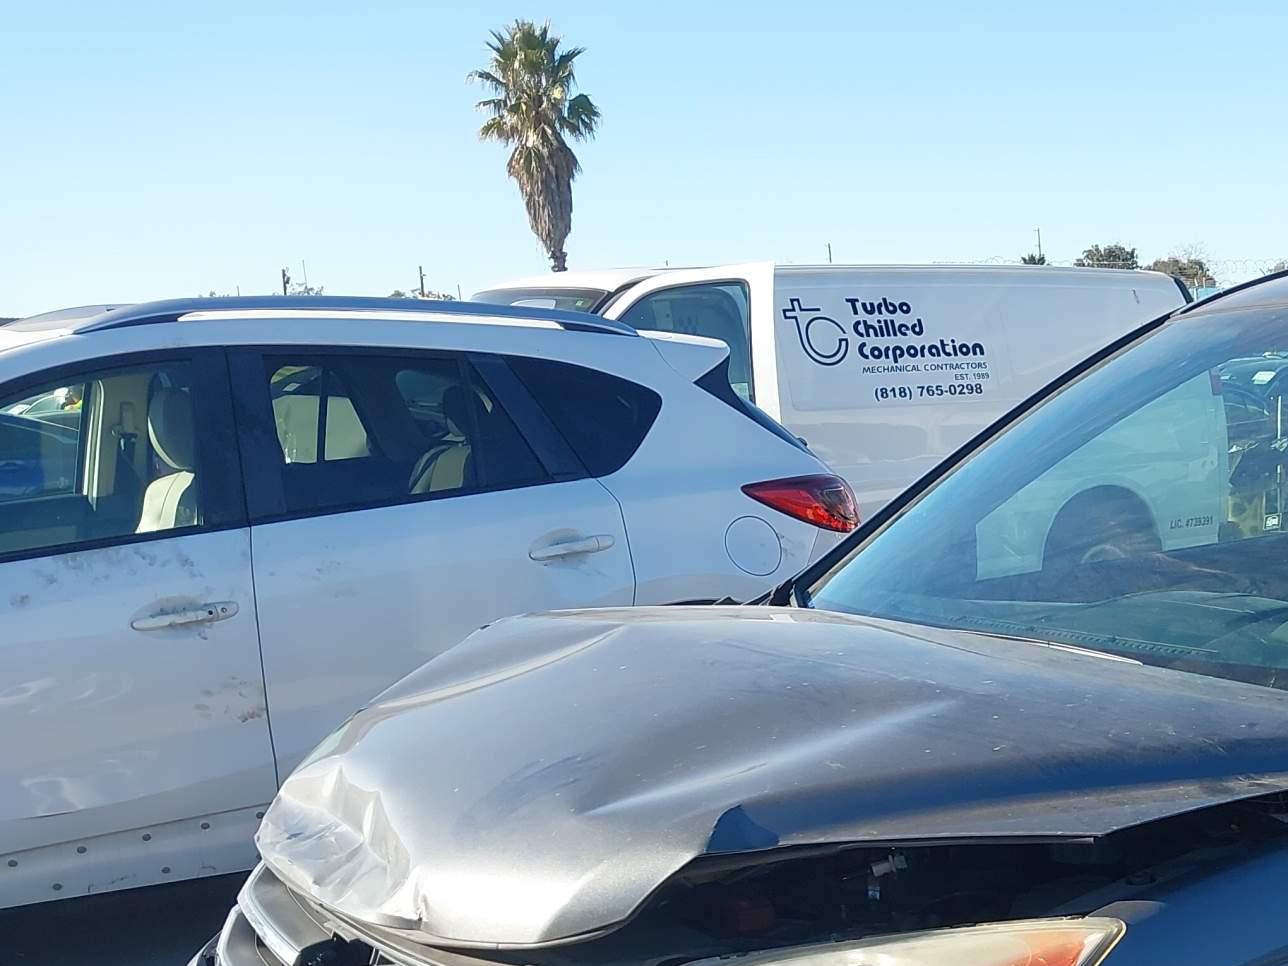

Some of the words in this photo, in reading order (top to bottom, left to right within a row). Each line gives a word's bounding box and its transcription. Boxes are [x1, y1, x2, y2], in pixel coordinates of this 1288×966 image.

[845, 297, 911, 316] Turbo
[852, 318, 924, 338] Chilled
[858, 339, 985, 363] Corporation
[862, 364, 921, 375] MECHANICAL
[923, 361, 988, 372] CONTRACTORS
[954, 373, 971, 381] EST.
[972, 372, 990, 381] 1989
[874, 387, 913, 401] (818)
[917, 383, 983, 397] 765-0298
